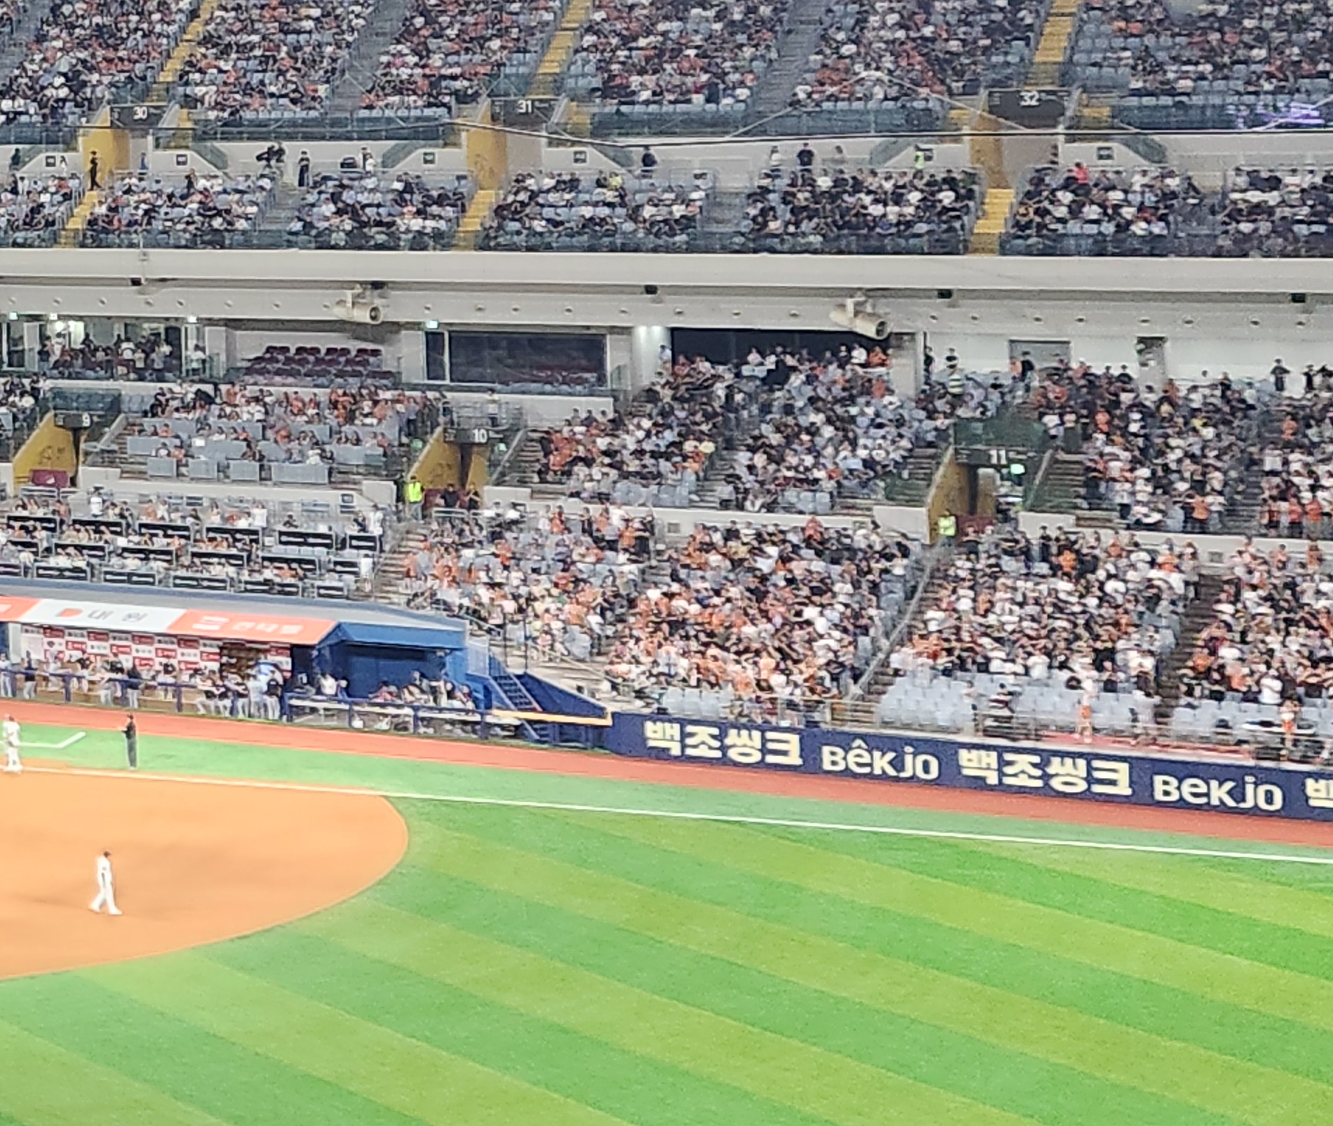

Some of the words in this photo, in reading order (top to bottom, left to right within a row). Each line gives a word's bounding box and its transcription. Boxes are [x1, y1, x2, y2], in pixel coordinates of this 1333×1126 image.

[517, 99, 533, 113] 31
[1019, 90, 1039, 106] 32
[133, 105, 147, 120] 30
[474, 429, 488, 445] 10
[989, 449, 1007, 466] 11
[644, 720, 804, 766] 백조씽크
[957, 748, 1132, 797] 백조씽크
